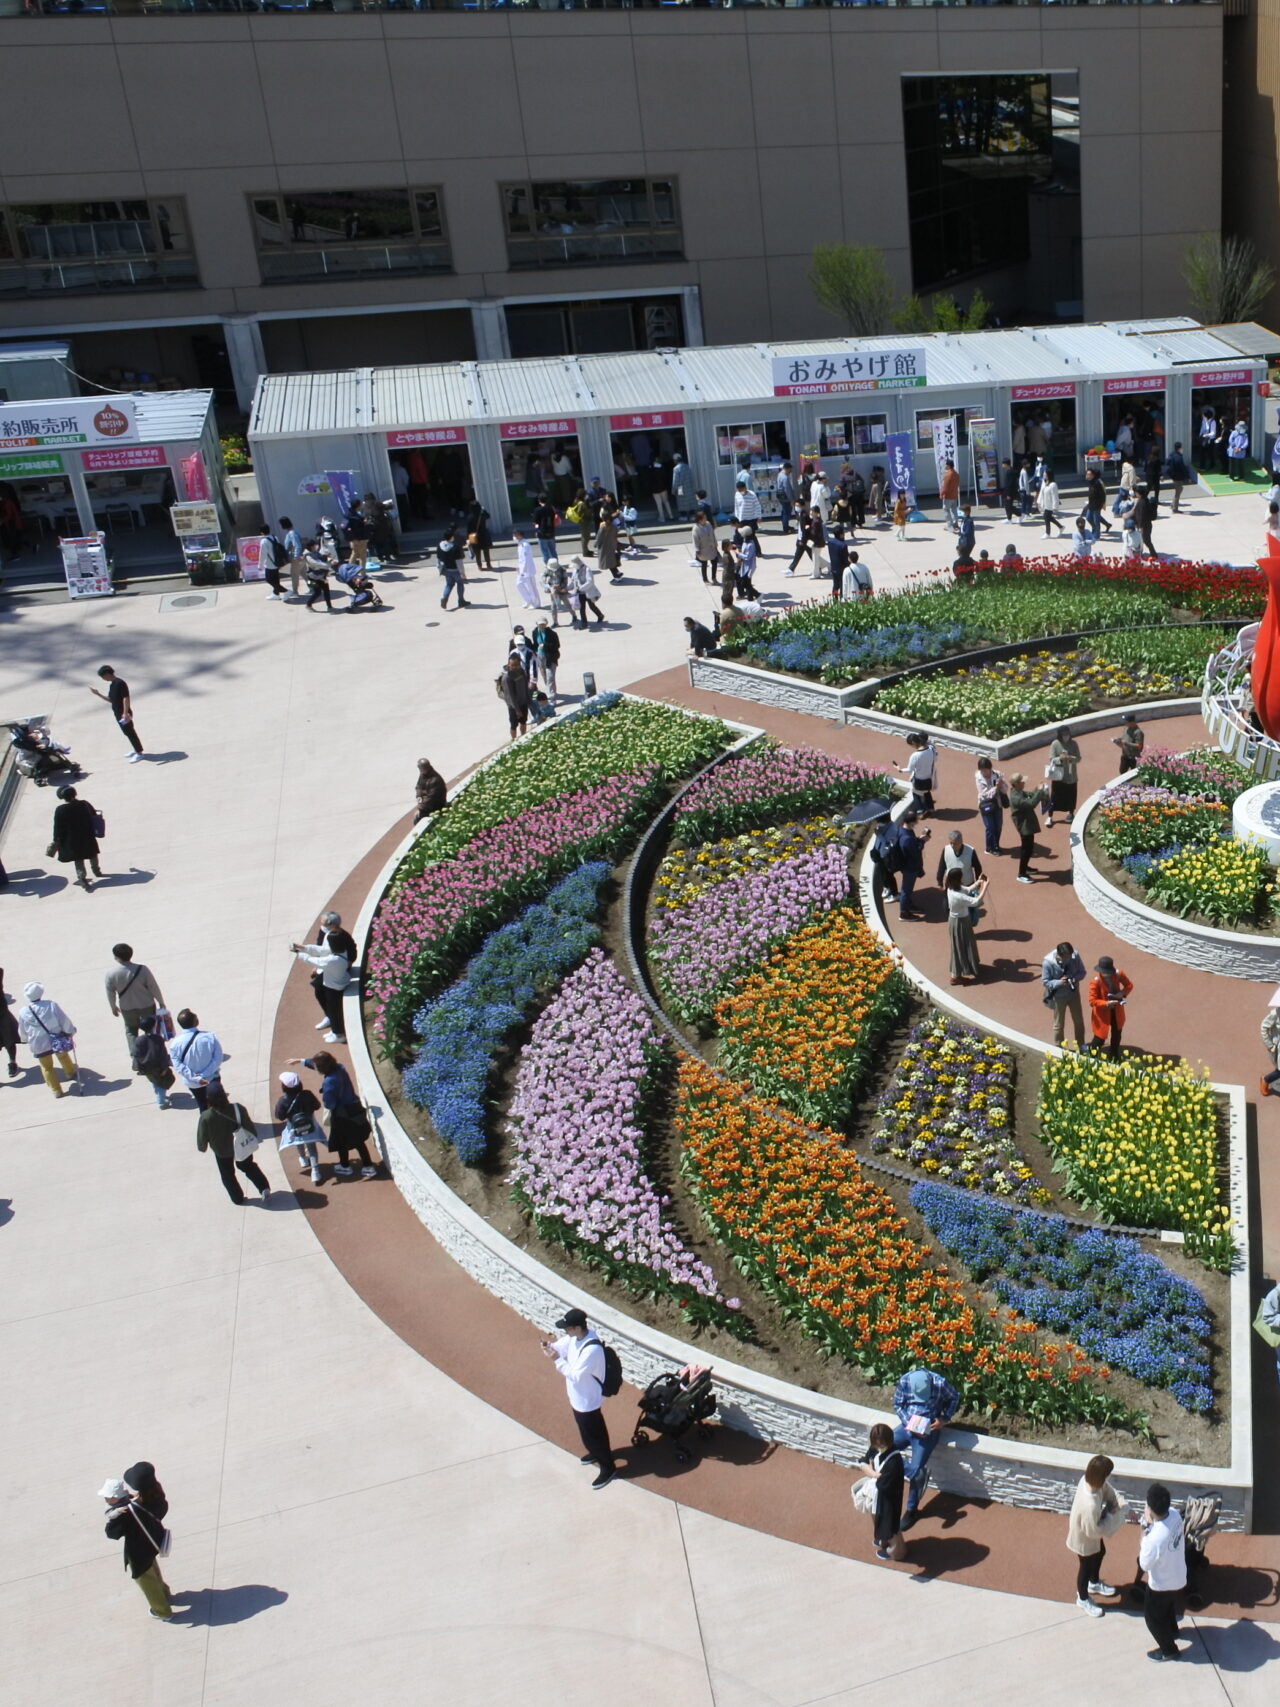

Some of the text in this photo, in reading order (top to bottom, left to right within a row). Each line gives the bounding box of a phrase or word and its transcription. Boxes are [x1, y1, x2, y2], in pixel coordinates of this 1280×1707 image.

[789, 354, 916, 382] おみやげ館
[788, 378, 918, 395] TONAMI OMIYAGE MARKET
[1015, 384, 1072, 397] チューリップグッズ
[507, 421, 569, 435] となみ特産品
[43, 435, 82, 446] MARKET
[395, 429, 457, 444] とやま特産品
